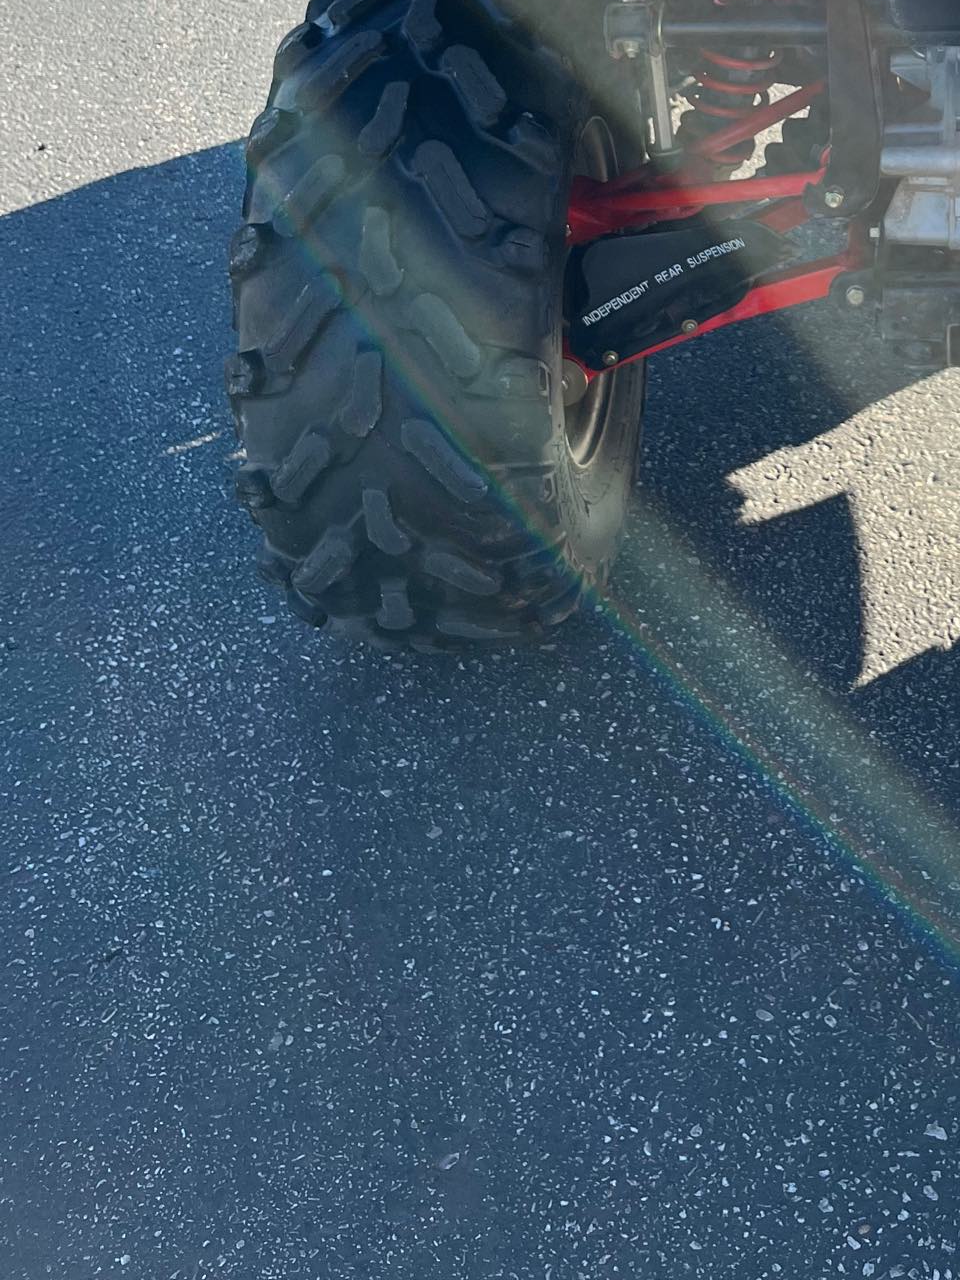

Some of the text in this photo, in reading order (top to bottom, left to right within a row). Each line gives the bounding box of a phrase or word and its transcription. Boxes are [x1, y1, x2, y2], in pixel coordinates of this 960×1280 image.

[582, 237, 746, 327] INDEPENDENT REAR SUSPENSION
